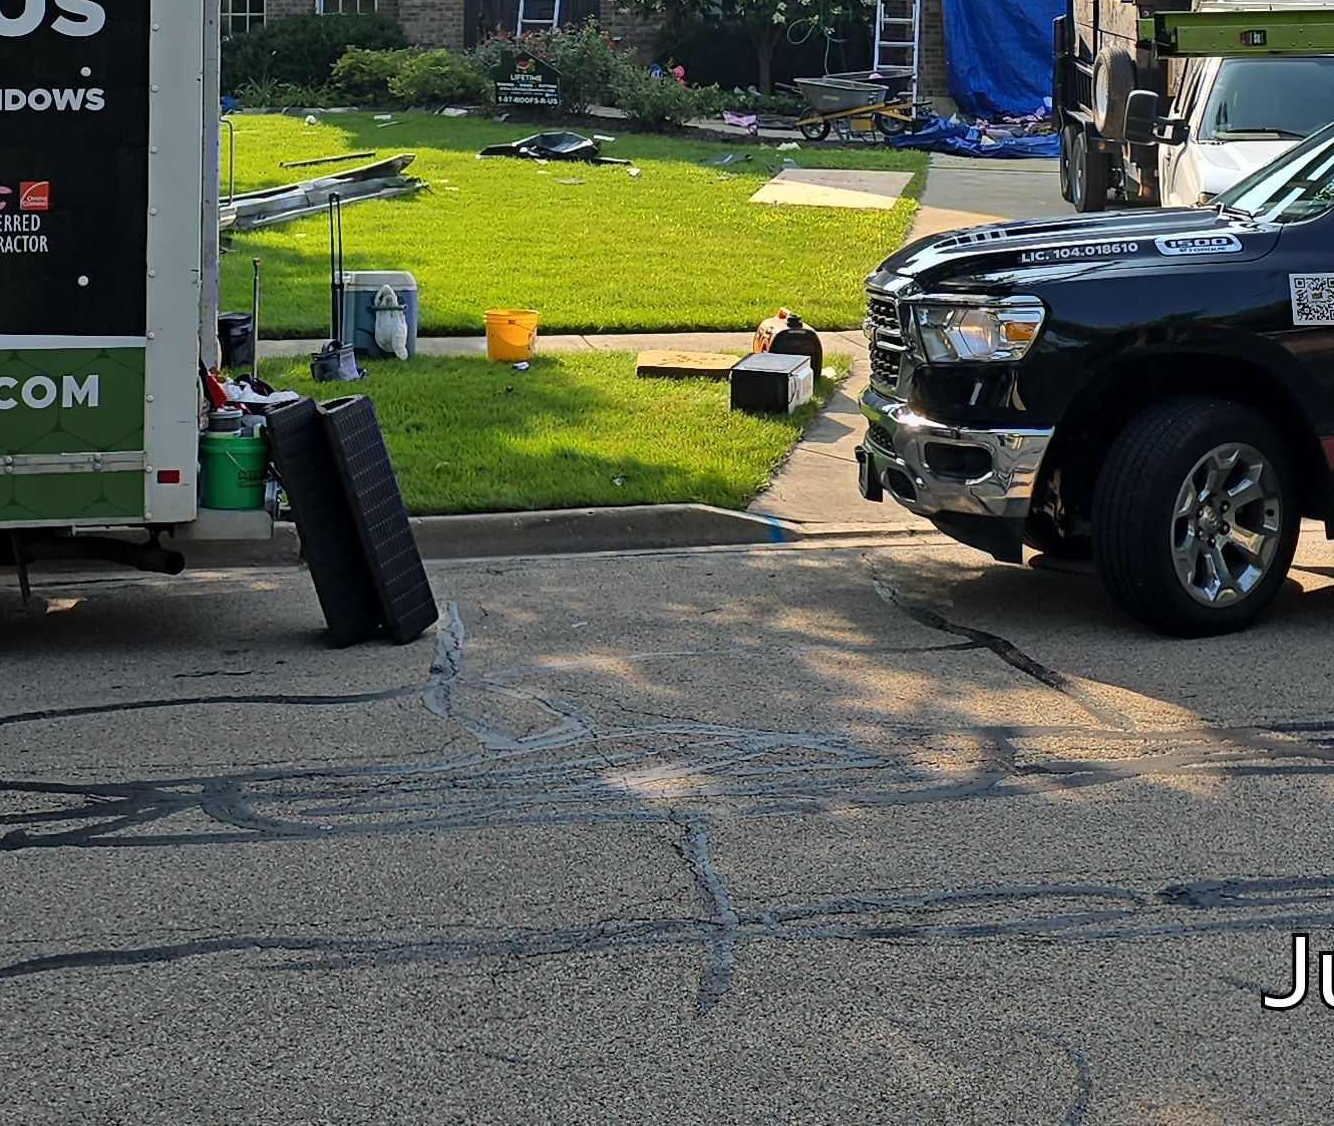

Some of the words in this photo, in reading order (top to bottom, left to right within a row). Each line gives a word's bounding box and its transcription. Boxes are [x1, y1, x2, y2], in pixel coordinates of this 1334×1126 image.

[1170, 238, 1227, 248] 1500
[1021, 250, 1049, 263] LIC.
[1053, 242, 1138, 260] 104.018610
